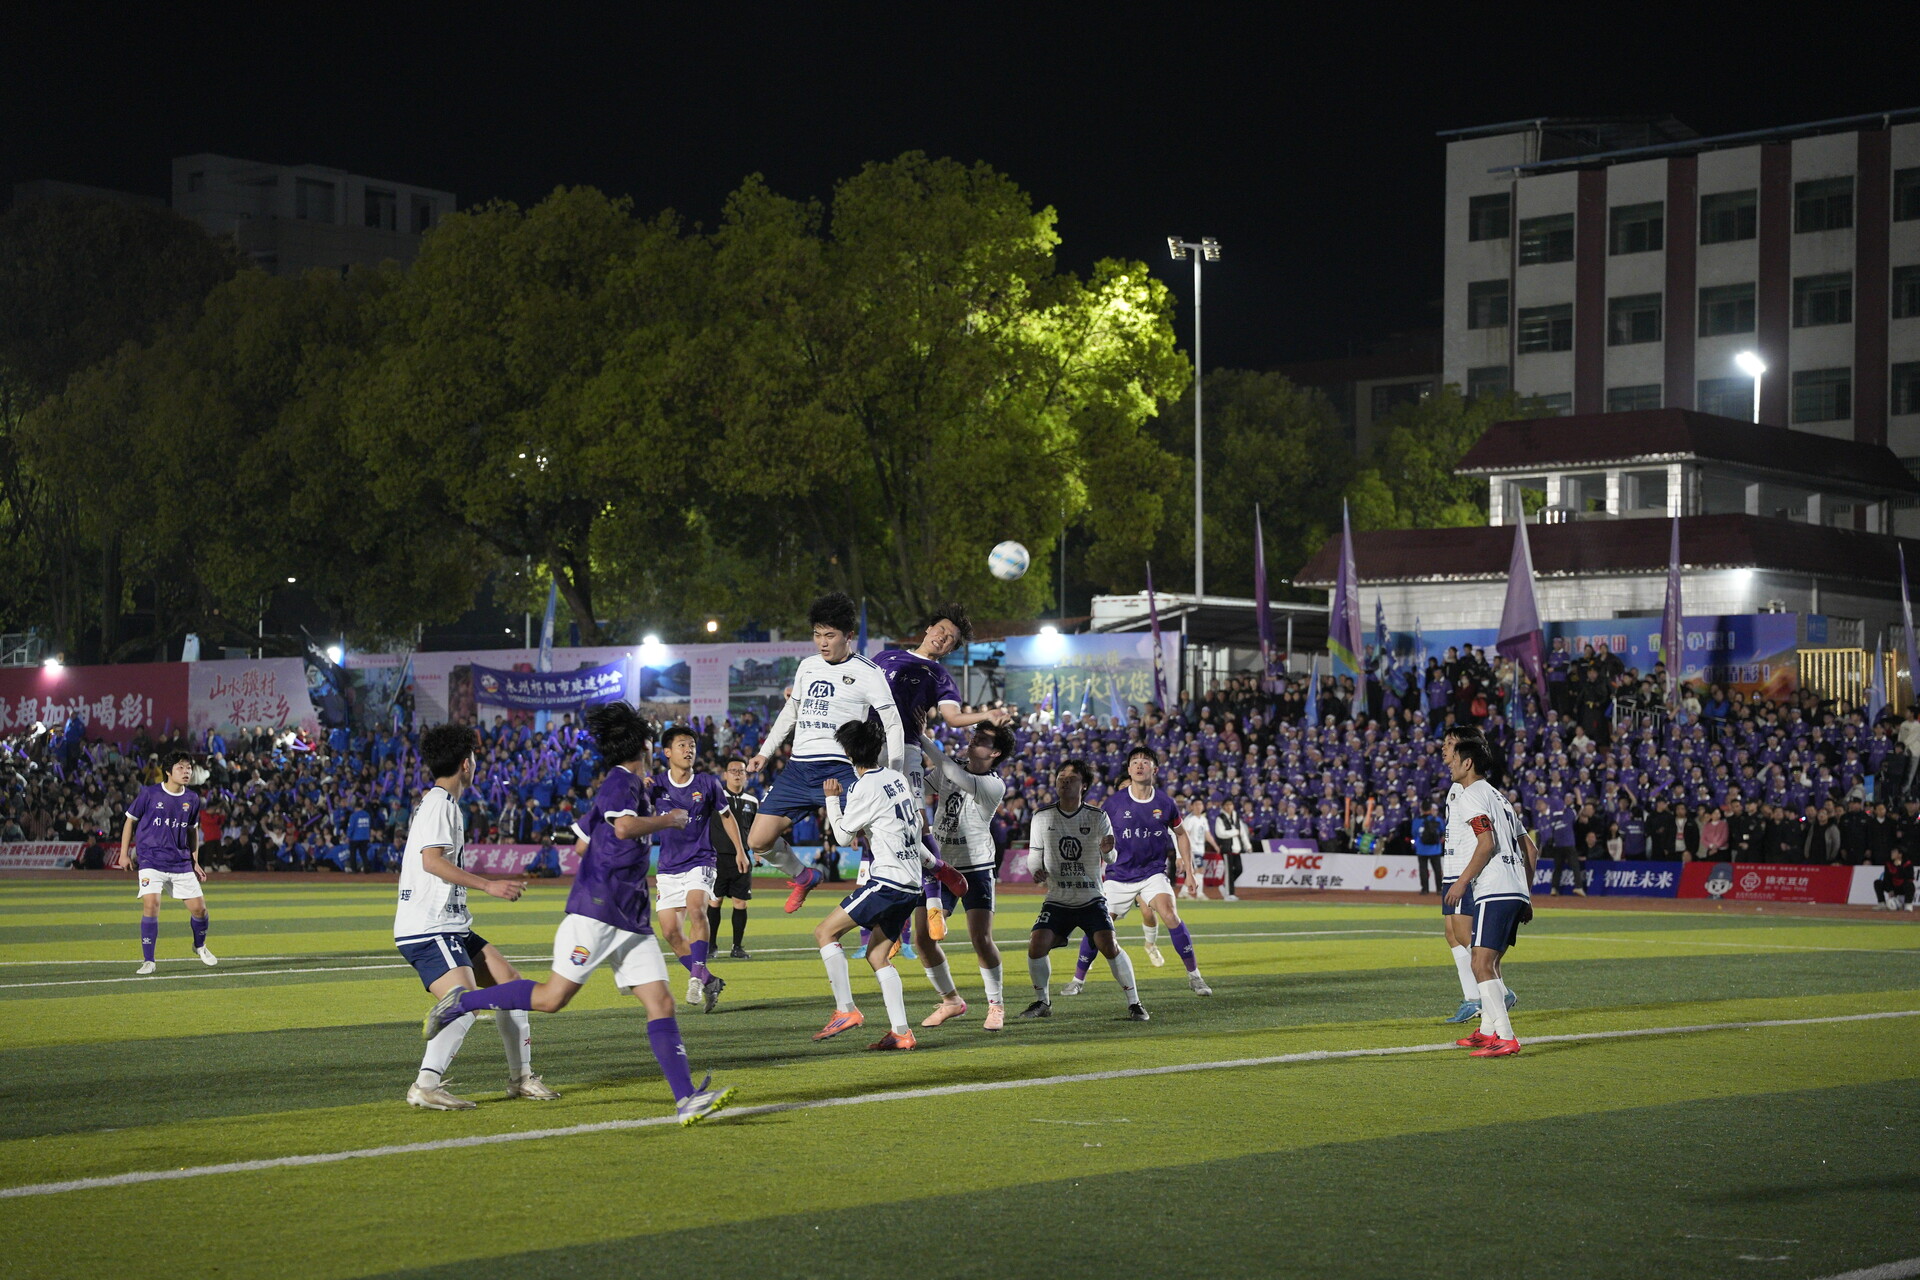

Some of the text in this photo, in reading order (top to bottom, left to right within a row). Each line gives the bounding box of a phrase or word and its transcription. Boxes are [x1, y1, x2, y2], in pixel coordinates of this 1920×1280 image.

[1285, 855, 1323, 870] PICC
[1256, 874, 1343, 887] 中国人民保险
[1604, 869, 1673, 889] 智胜未来
